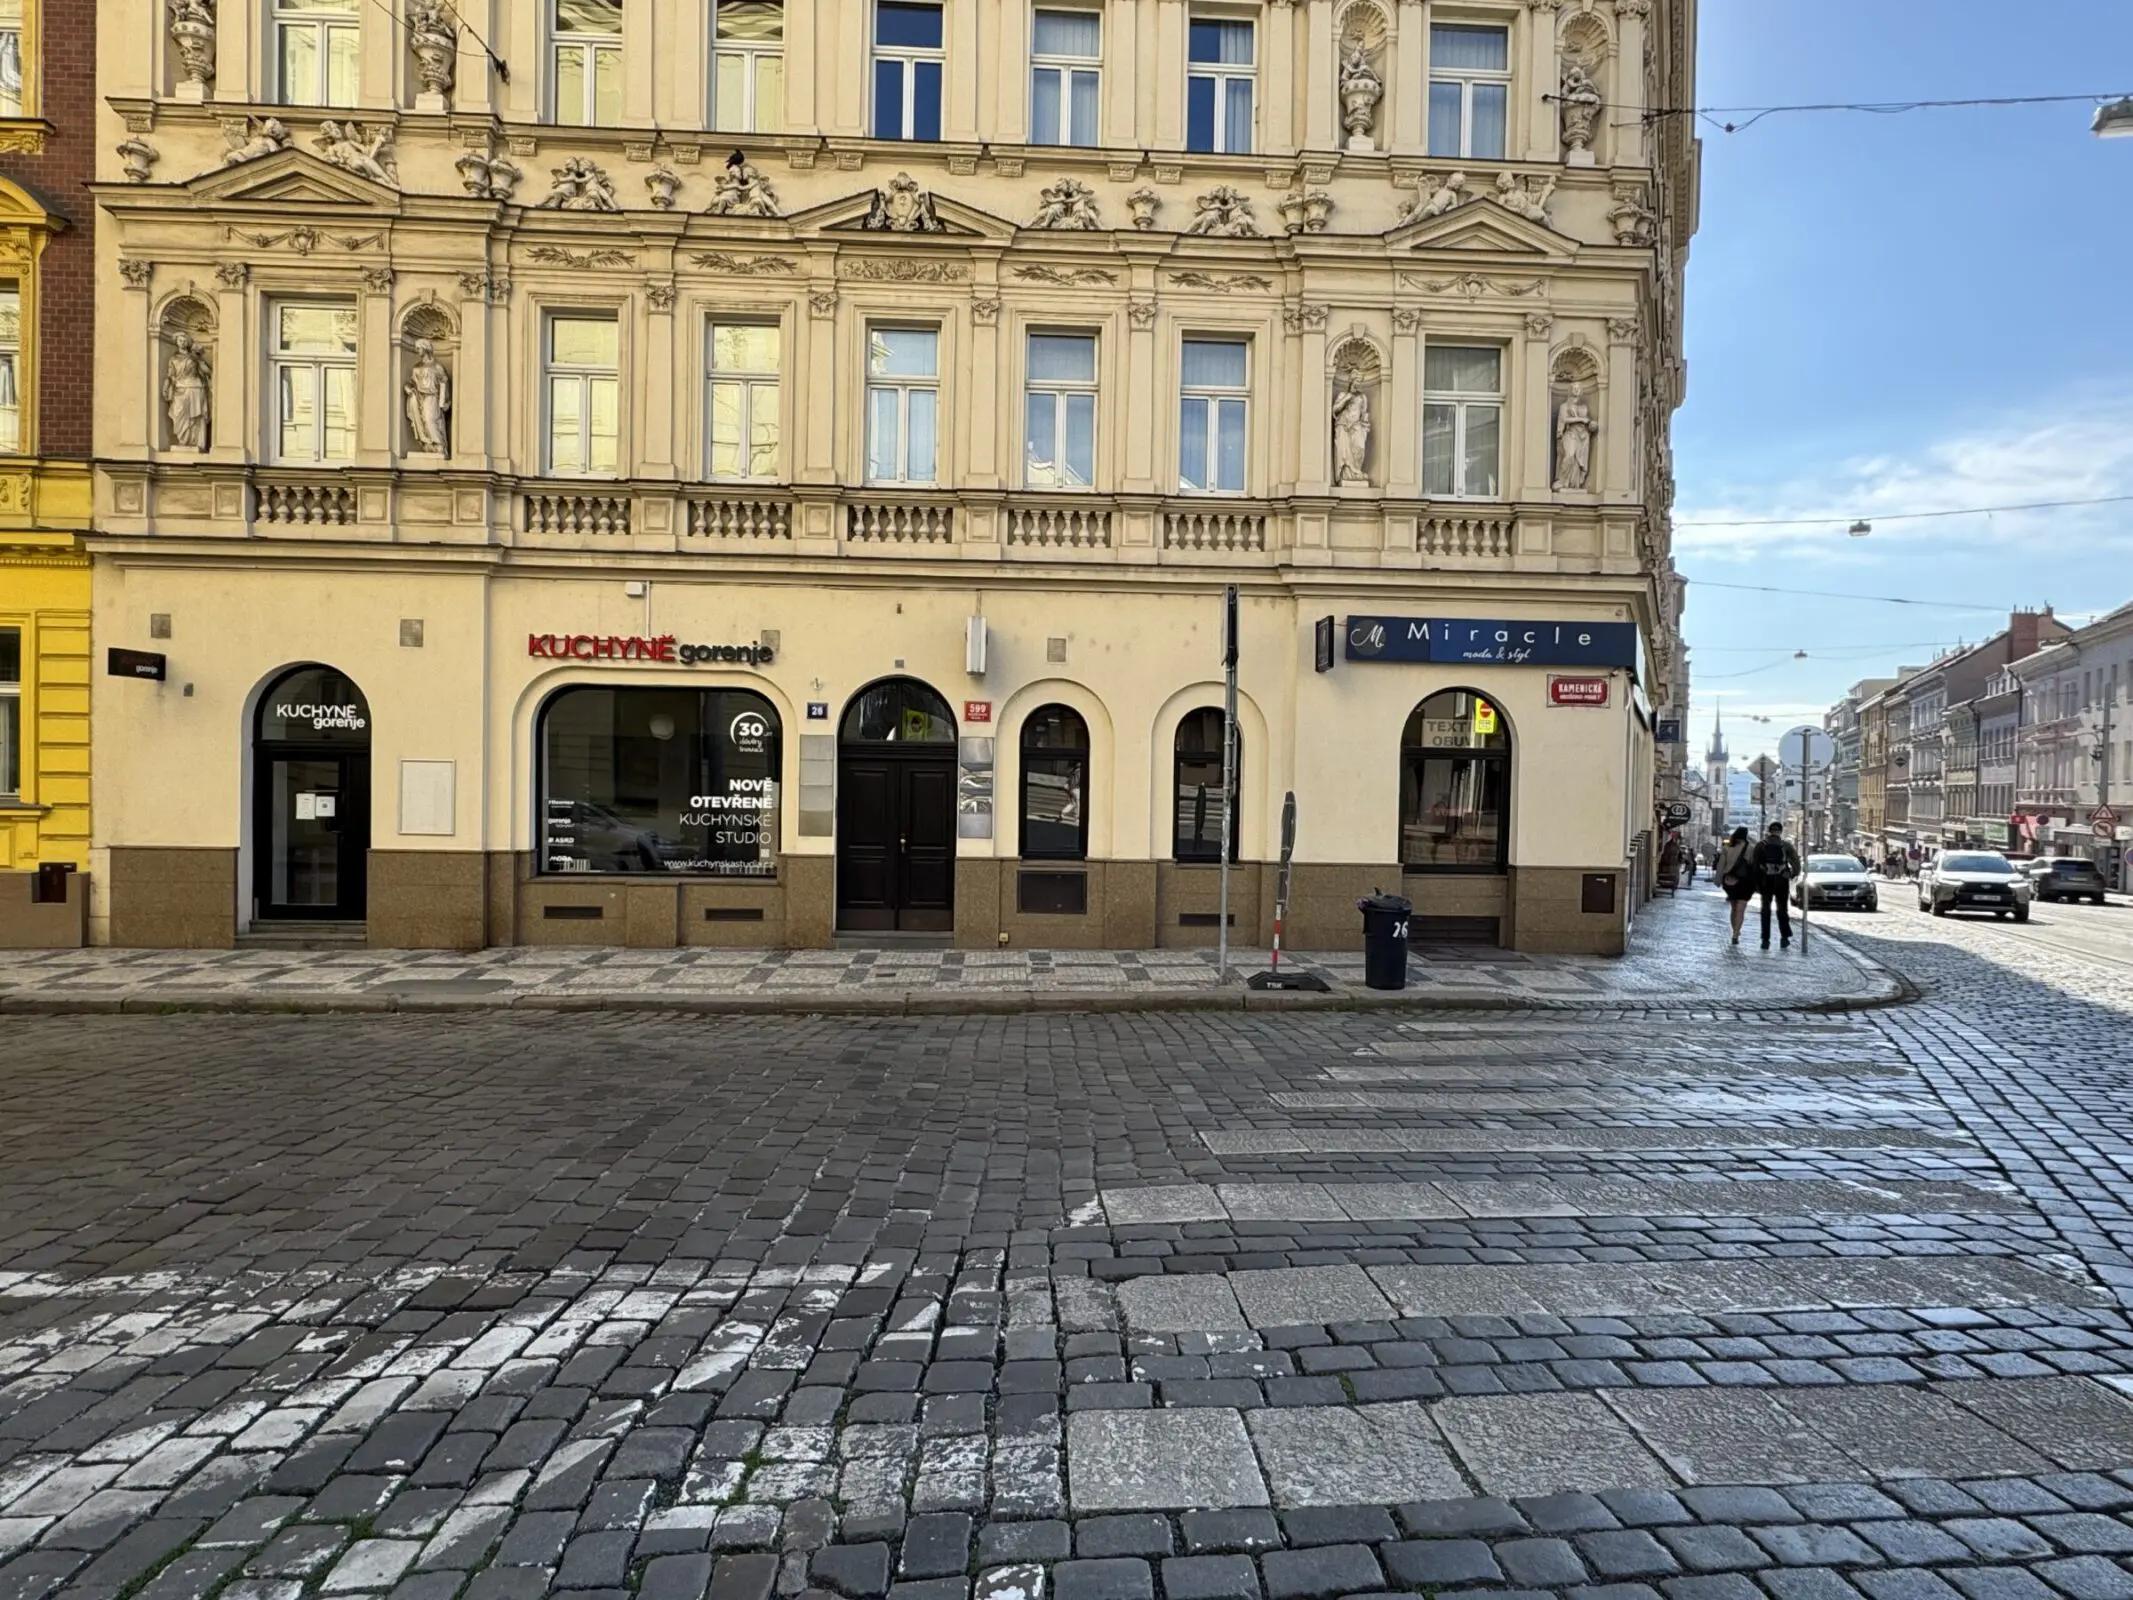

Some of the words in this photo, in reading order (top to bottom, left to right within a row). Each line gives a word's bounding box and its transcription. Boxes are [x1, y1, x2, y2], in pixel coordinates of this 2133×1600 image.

[1407, 622, 1591, 646] Miracle
[528, 634, 676, 662] KUCHYNĚ
[679, 641, 774, 666] gorenje
[1463, 648, 1493, 659] moda
[1495, 646, 1505, 659] &
[276, 703, 357, 719] KUCHYNĚ
[313, 717, 366, 730] gorenje
[738, 722, 764, 737] 30
[729, 777, 774, 792] NOVĚ
[690, 794, 774, 809] OTEVŘENÉ
[679, 812, 773, 827] KUCHYNSKÉ
[715, 831, 772, 844] STUDIO
